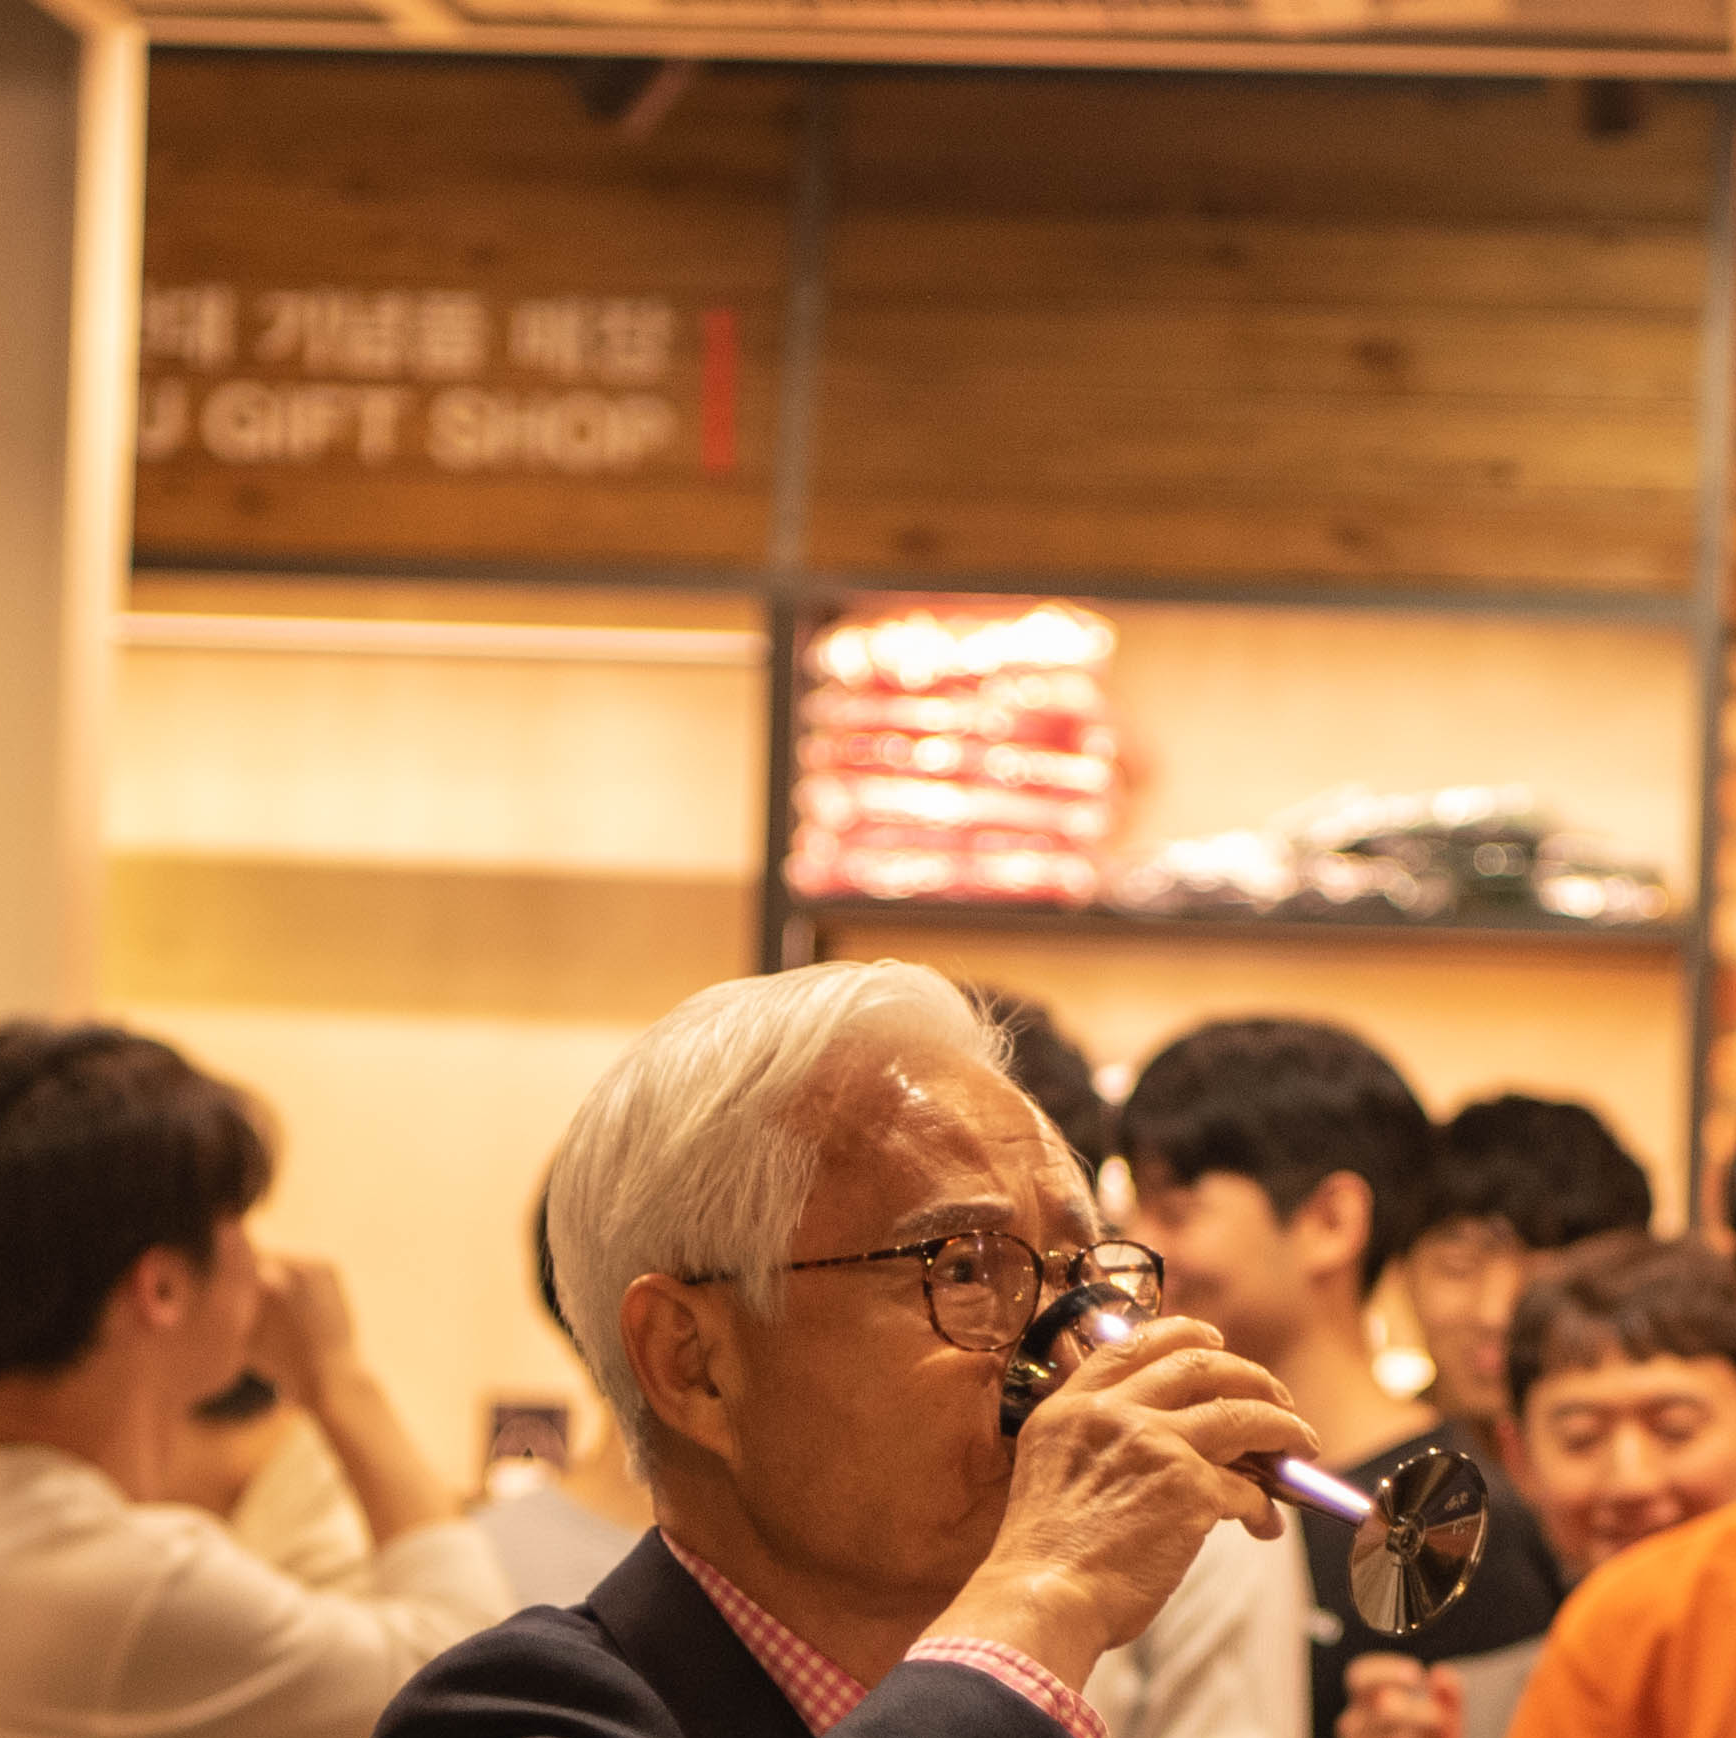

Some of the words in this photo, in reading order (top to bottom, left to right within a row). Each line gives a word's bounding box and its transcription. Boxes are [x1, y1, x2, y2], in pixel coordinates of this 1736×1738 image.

[256, 289, 485, 381] 기념품
[508, 298, 673, 385] 매장
[200, 378, 406, 466] GIFT
[427, 387, 677, 472] SHOP
